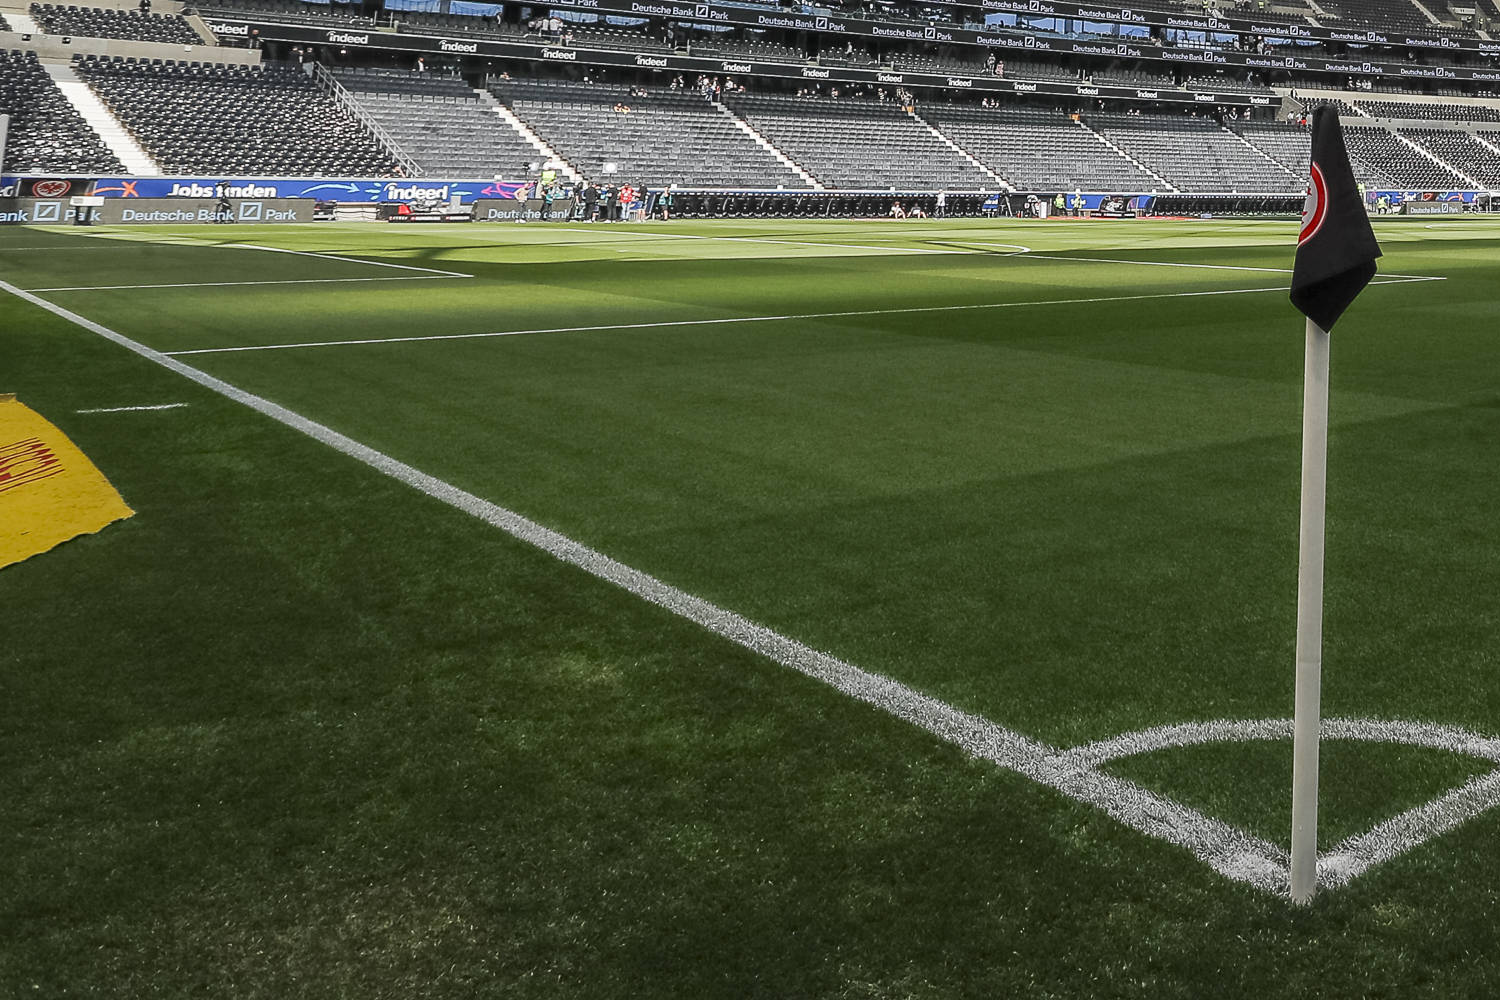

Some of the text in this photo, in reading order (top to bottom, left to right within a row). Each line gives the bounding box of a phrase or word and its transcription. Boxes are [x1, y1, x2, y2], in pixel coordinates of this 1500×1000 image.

[632, 3, 728, 20] Deutsche Bank Park
[982, 0, 1054, 14] Deutsche Bank Park
[759, 16, 846, 32] Deutsche Bank Park
[326, 30, 369, 45] indeed
[873, 27, 952, 40] Deutsche Bank Park
[439, 39, 477, 53] indeed
[977, 36, 1050, 49] Deutsche Bank Park
[541, 47, 576, 60] indeed
[167, 183, 213, 198] Jobs
[383, 183, 449, 200] indeed
[0, 210, 29, 222] ank
[122, 209, 195, 221] Deutsche
[265, 209, 297, 221] Park
